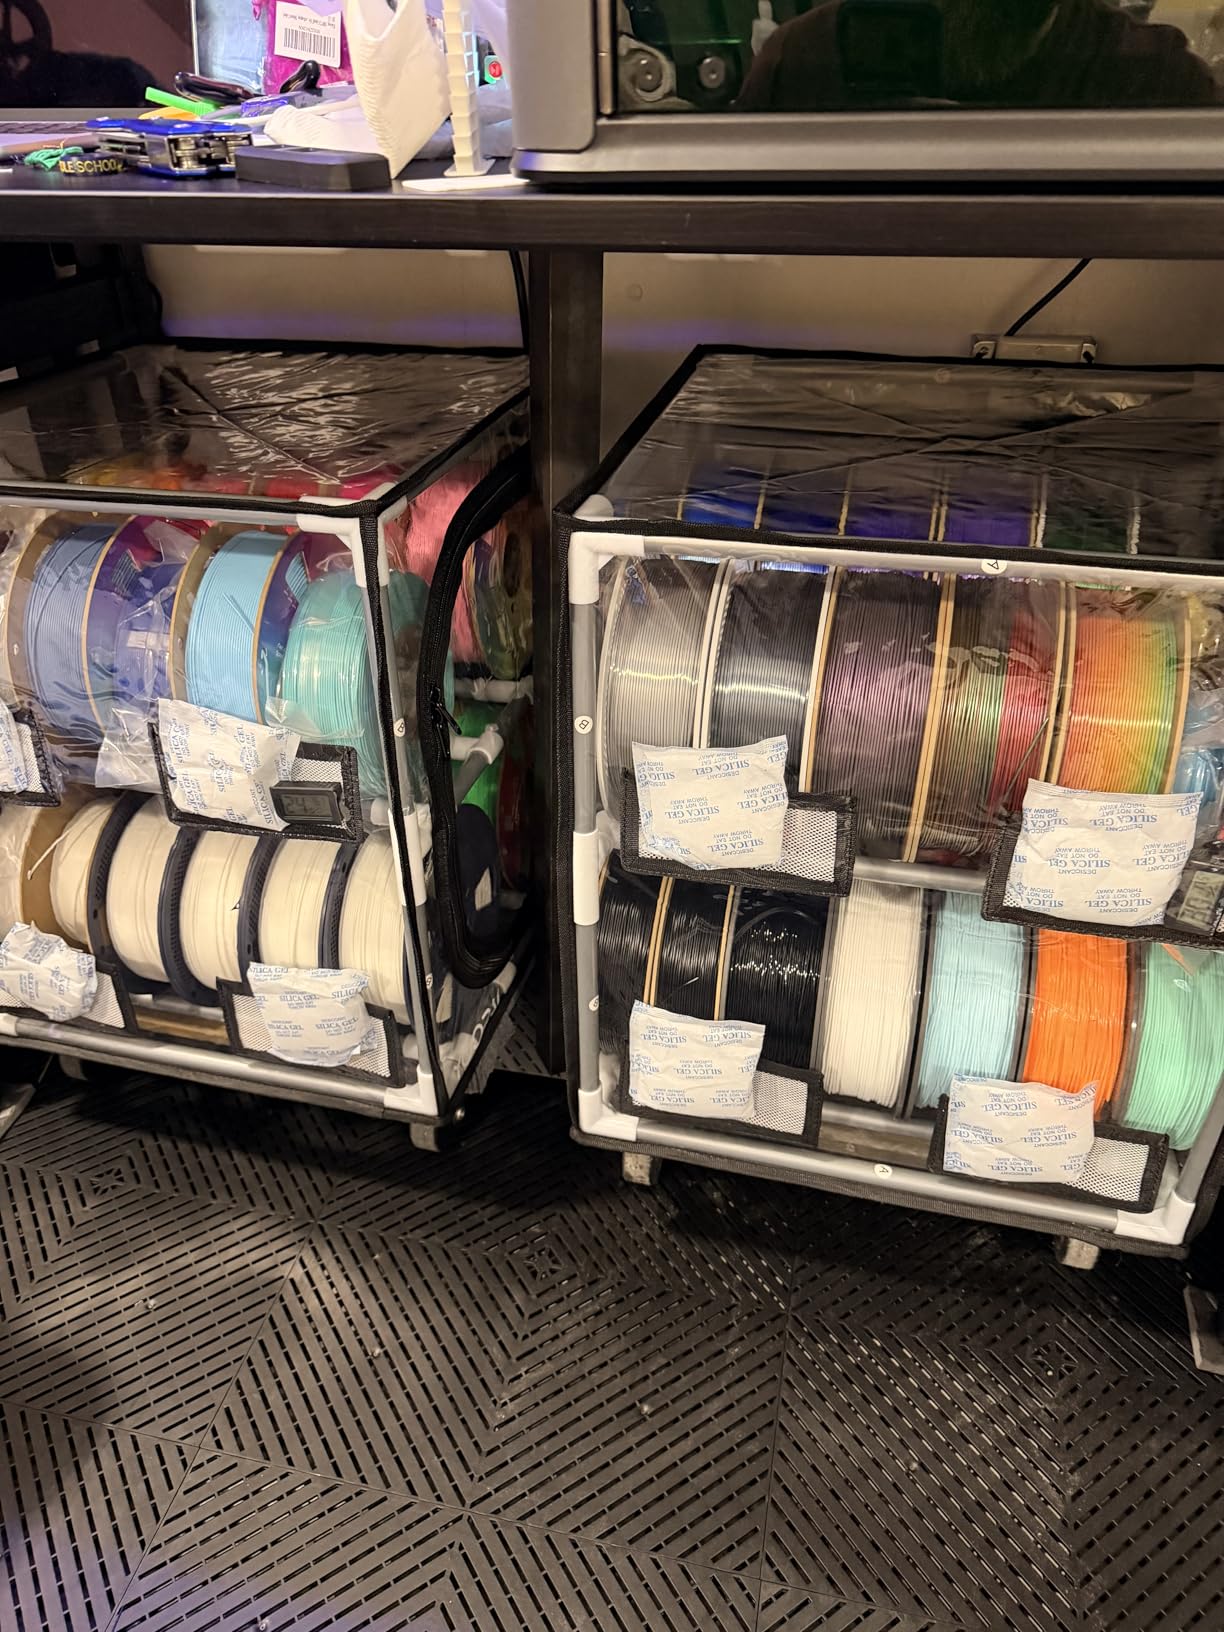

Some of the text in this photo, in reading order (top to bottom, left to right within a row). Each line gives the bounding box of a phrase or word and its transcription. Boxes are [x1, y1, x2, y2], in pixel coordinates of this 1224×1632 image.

[767, 752, 787, 764] GEL
[692, 760, 750, 776] SILICA GEL
[737, 800, 758, 809] GEL
[260, 796, 274, 824] SILICA
[664, 806, 720, 819] SILICA GEL
[1176, 805, 1198, 816] GEL
[1031, 818, 1068, 828] SILICA
[1089, 815, 1158, 826] SILICA GEL
[1106, 824, 1144, 832] DESICCANT
[707, 838, 764, 852] SILICA GEL
[1046, 858, 1110, 868] SILICA GEL
[1132, 857, 1156, 866] GEL
[1026, 898, 1064, 908] SILICA
[1112, 898, 1152, 908] SILICA
[659, 1035, 686, 1044] SILICA
[702, 1032, 752, 1042] SILICA GEL
[736, 1064, 756, 1074] GEL
[648, 1094, 665, 1102] GEL
[980, 1101, 1038, 1112] SILICA GEL
[950, 1130, 1004, 1144] SILICA GEL
[1044, 1132, 1077, 1142] SILICA
